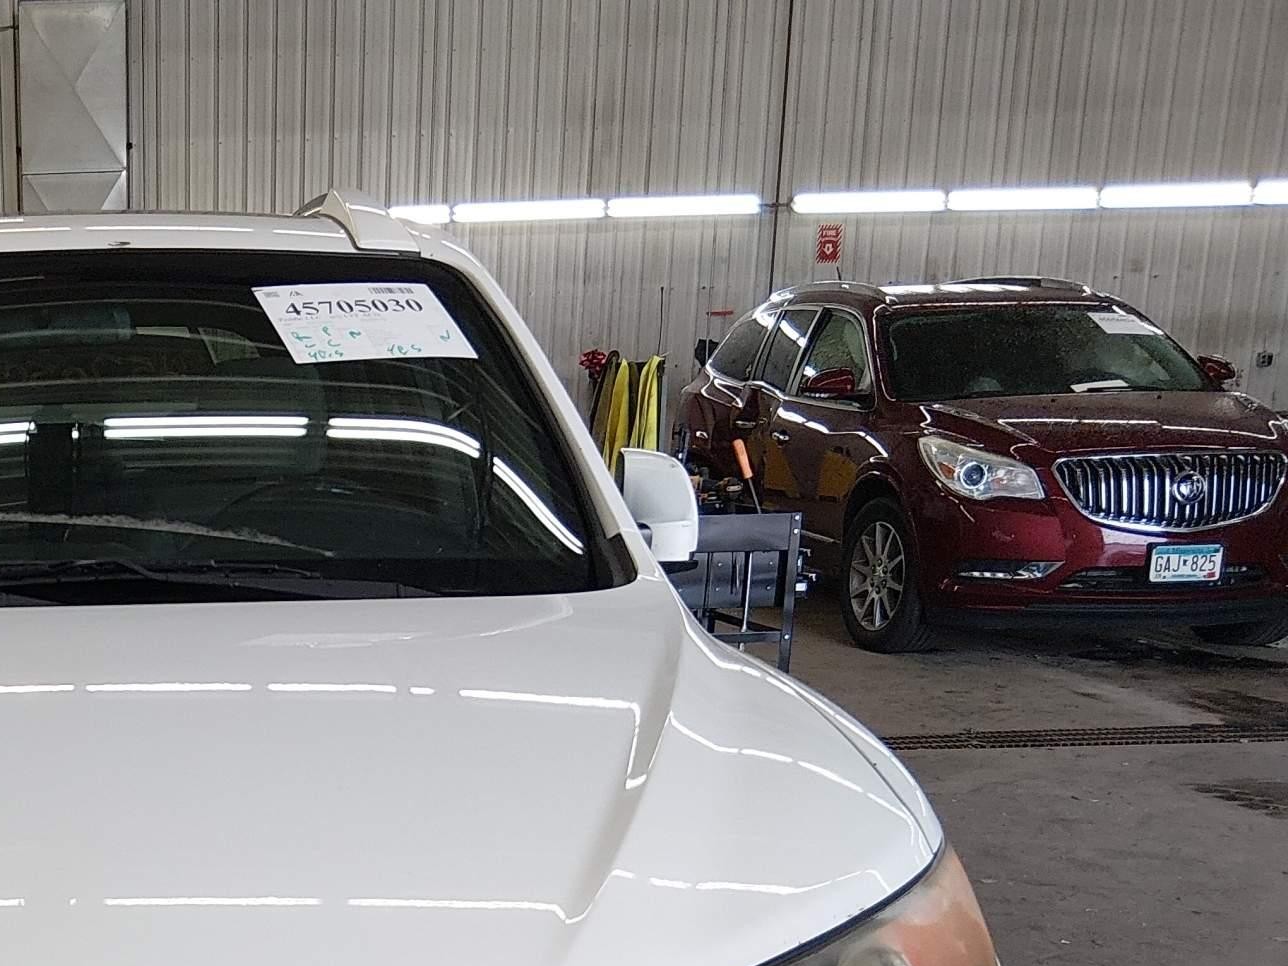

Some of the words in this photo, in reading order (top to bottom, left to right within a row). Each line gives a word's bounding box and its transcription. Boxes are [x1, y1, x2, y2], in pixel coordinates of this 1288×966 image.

[285, 299, 424, 317] 45705030
[1154, 555, 1182, 573] GAJ
[1190, 554, 1217, 572] 825
